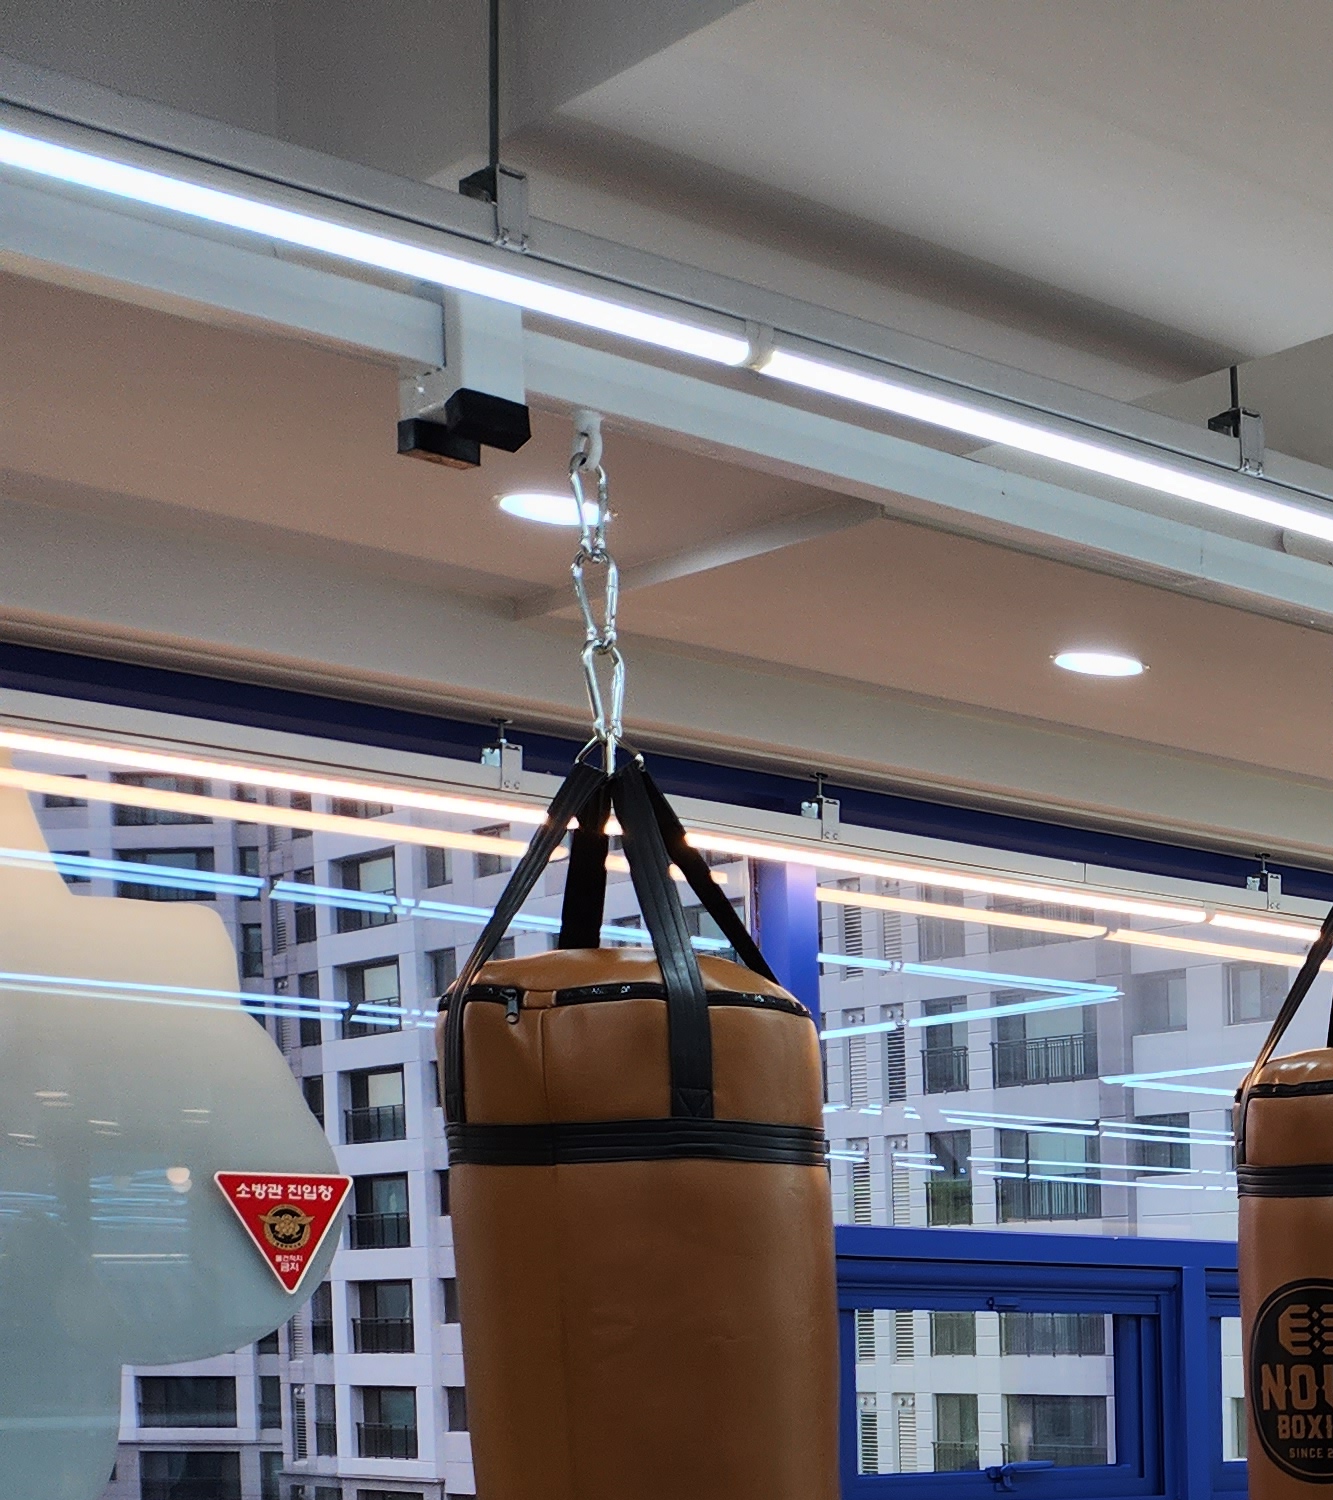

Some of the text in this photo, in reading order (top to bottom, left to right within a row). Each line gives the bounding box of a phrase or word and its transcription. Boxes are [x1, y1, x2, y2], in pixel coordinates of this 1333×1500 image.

[236, 1182, 334, 1201] 소방관 진입창
[1289, 1447, 1323, 1459] SINCE
